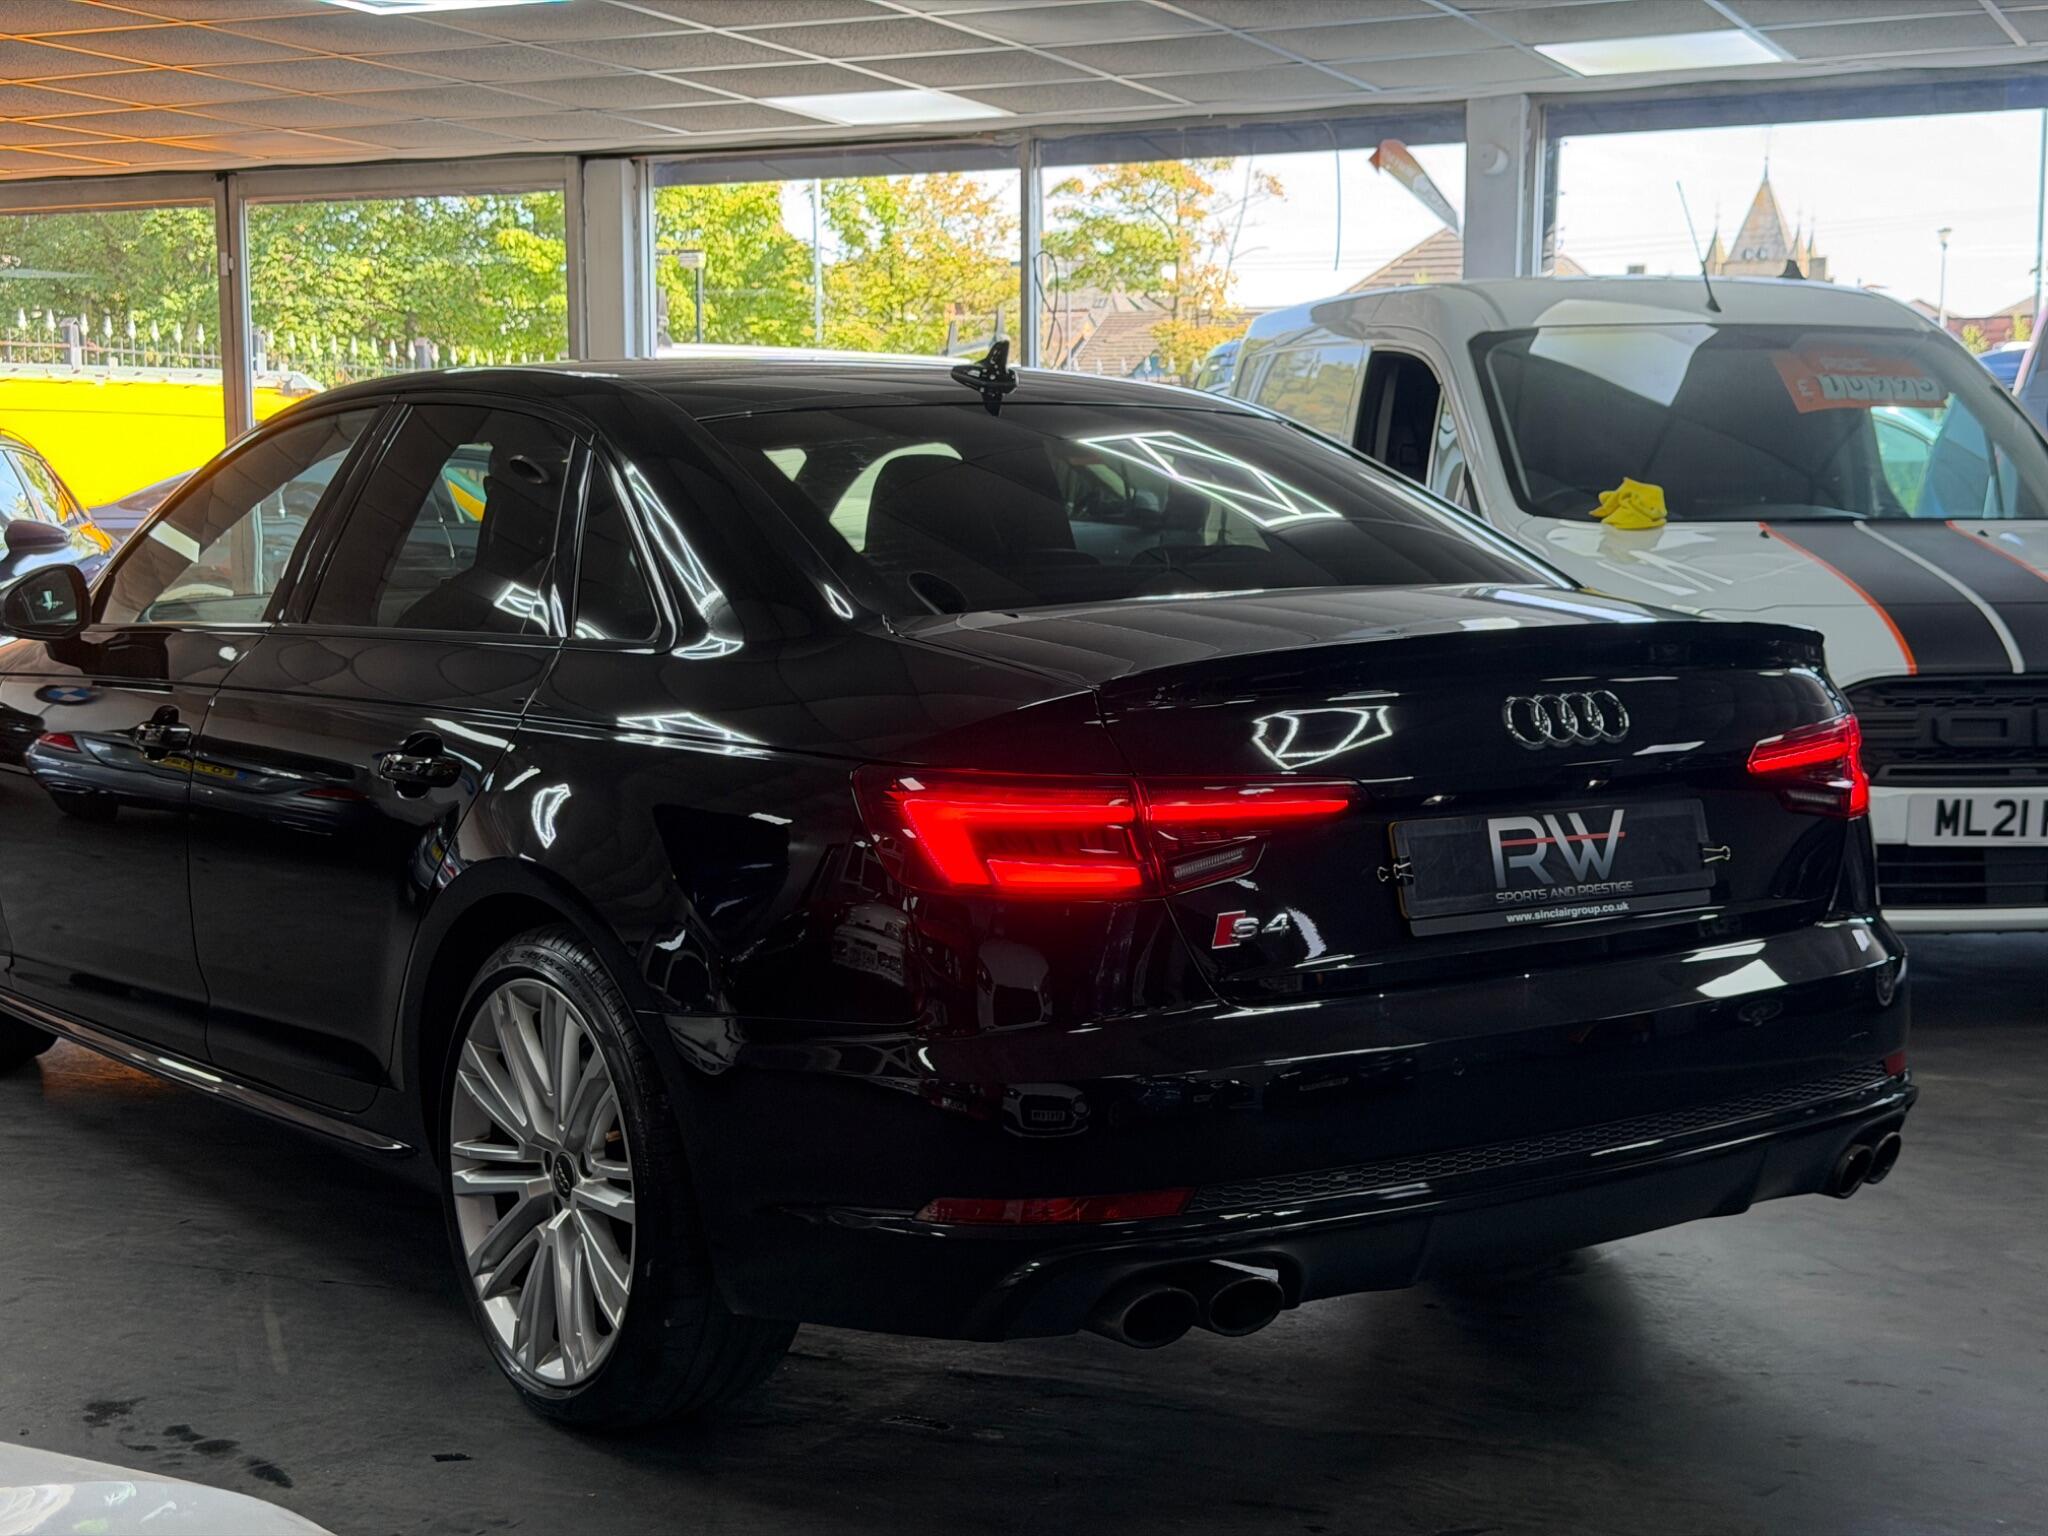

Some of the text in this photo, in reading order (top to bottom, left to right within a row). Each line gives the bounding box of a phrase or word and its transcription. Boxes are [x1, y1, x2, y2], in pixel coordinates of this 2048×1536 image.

[1934, 798, 2029, 837] ML21
[1487, 808, 1626, 889] RW
[1495, 880, 1634, 904] SPORTS AND PRESTIGE
[1505, 900, 1630, 923] www.sinclairgroup.co.uk
[1230, 912, 1290, 939] S4
